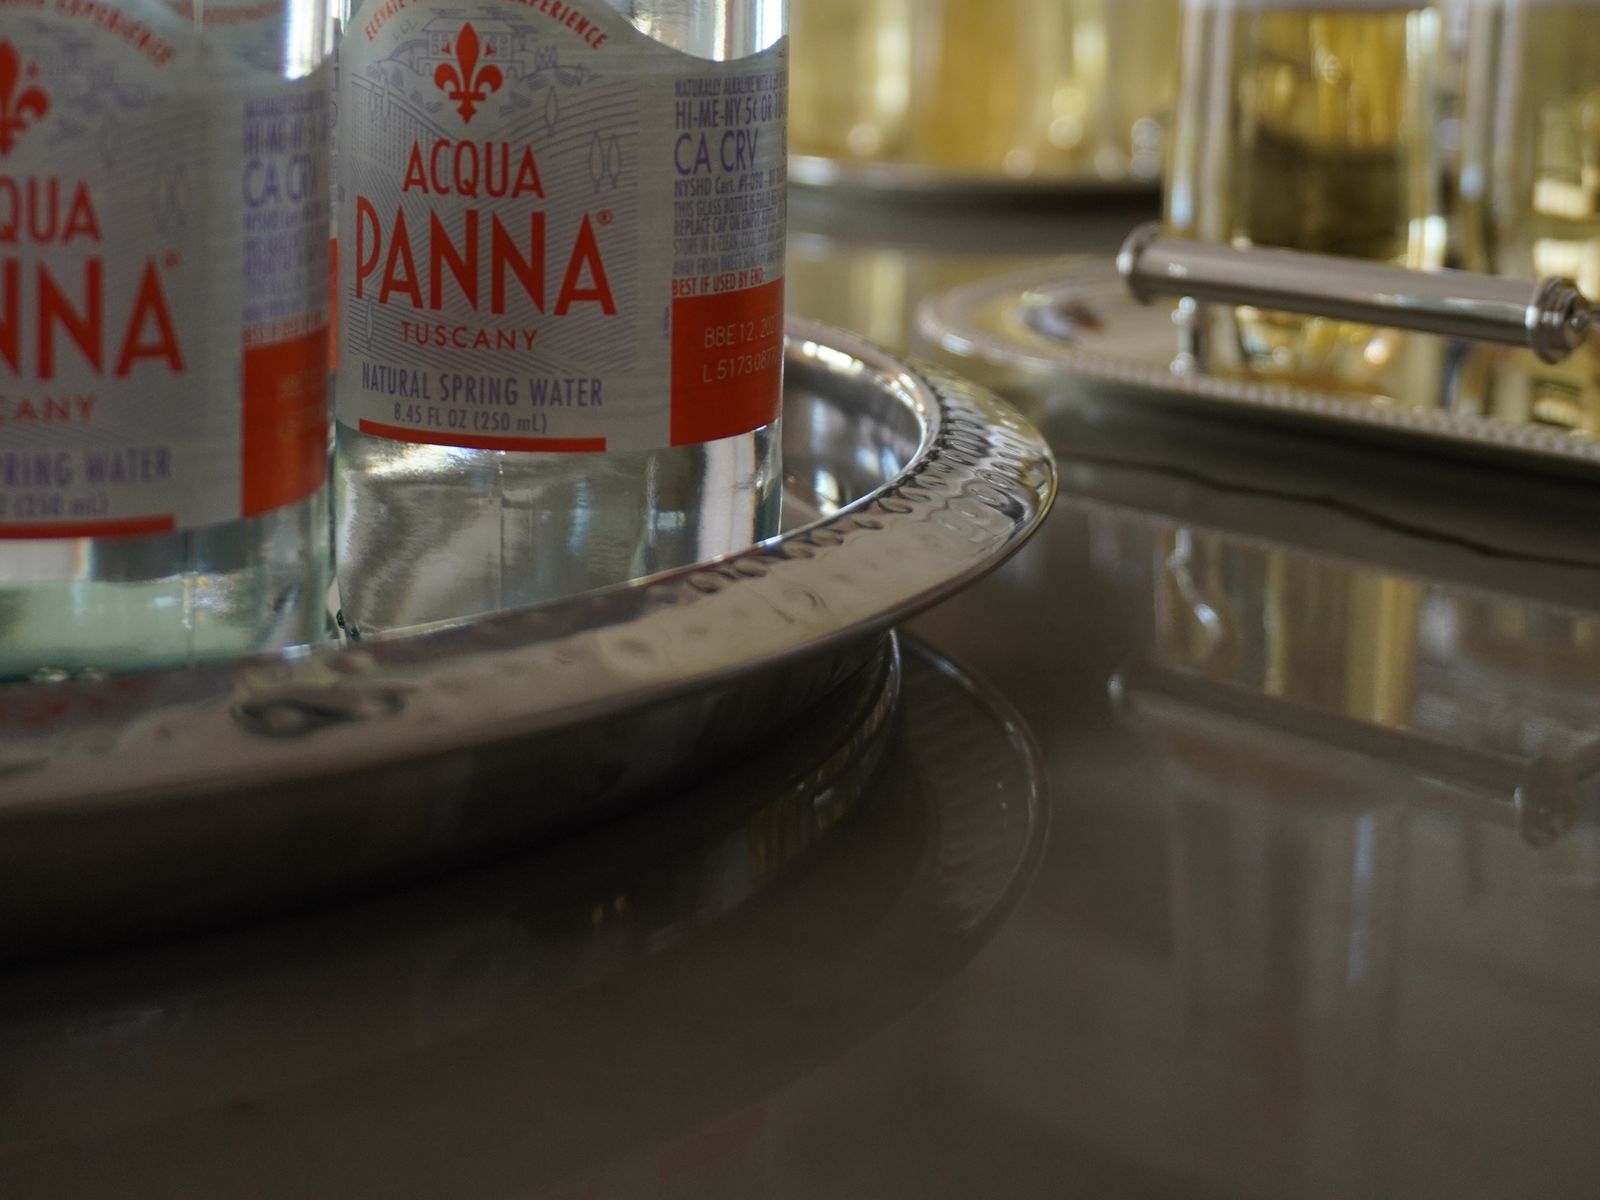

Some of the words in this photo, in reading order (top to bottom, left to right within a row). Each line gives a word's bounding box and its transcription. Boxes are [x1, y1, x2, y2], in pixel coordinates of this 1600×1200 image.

[675, 98, 742, 129] HI-ME-NY
[402, 138, 545, 199] ACQUA
[674, 131, 712, 176] CA
[720, 128, 759, 173] CRV
[356, 195, 618, 316] PANNA
[671, 277, 697, 296] BEST
[700, 275, 710, 293] IF
[713, 273, 737, 292] USED
[738, 271, 749, 289] BY
[401, 320, 538, 351] TUSCANY
[361, 361, 431, 401] NATURAL
[439, 373, 519, 406] SPRING
[529, 378, 603, 408] WATER
[393, 402, 422, 424] 8.45
[428, 406, 441, 427] FL
[448, 408, 467, 429] OZ
[473, 410, 511, 433] (250
[517, 414, 548, 434] mL)
[85, 446, 170, 485] WATER
